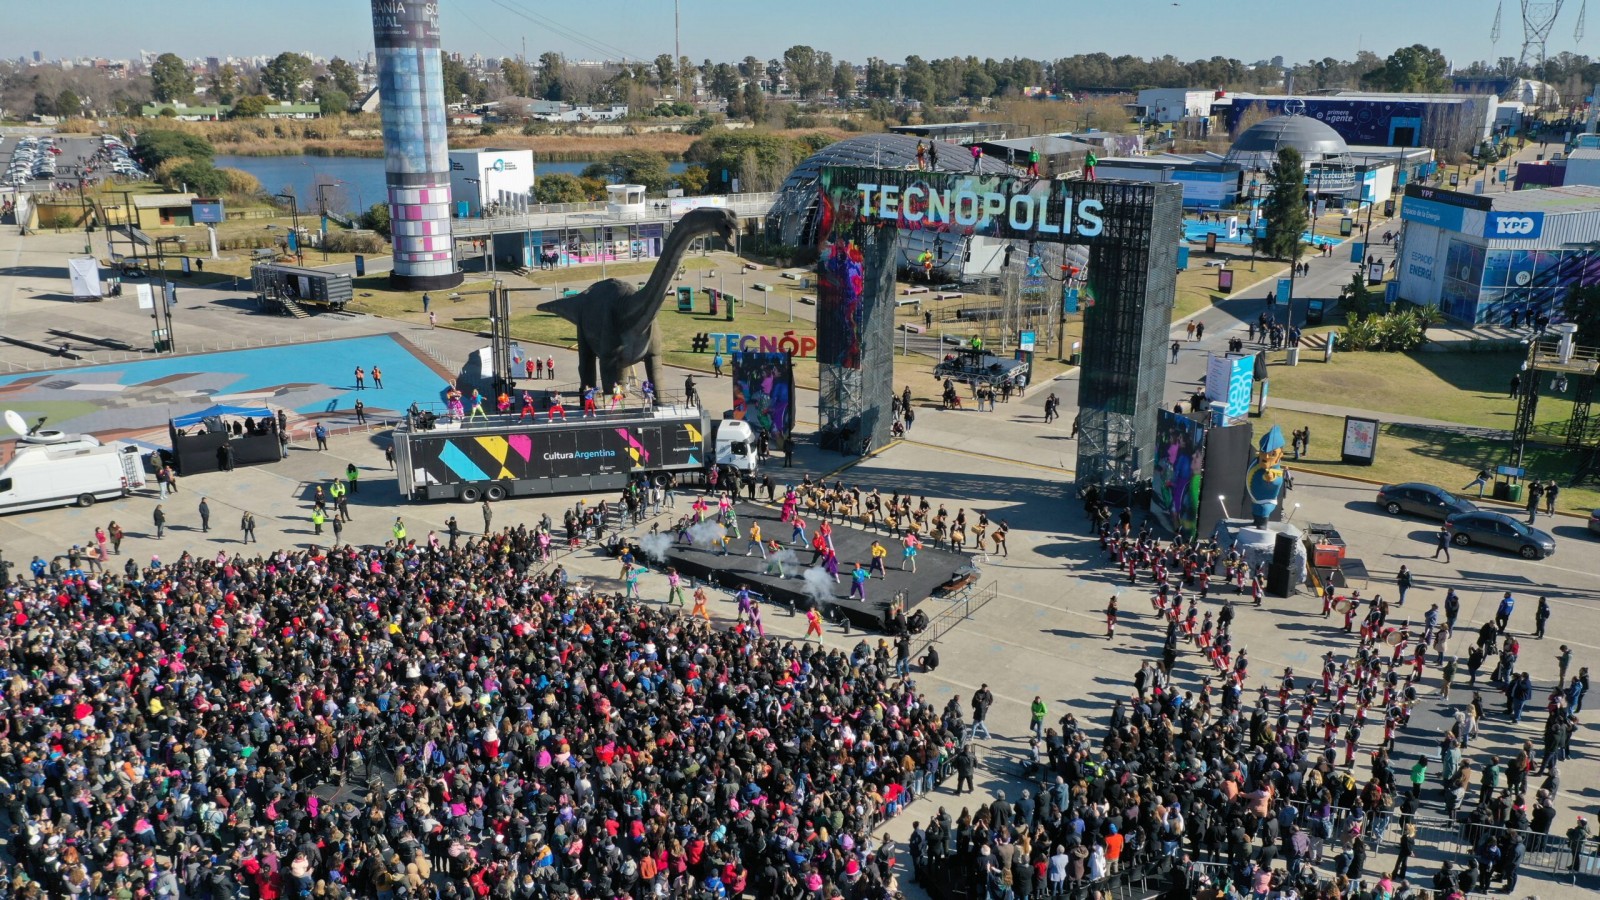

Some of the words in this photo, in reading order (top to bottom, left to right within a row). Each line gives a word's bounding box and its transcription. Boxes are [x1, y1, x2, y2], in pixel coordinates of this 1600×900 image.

[1421, 189, 1434, 198] YPF
[857, 180, 1104, 237] TECNÓPOLIS
[1503, 221, 1529, 229] YPF
[543, 452, 574, 460] Cultura
[574, 449, 616, 460] Argentina
